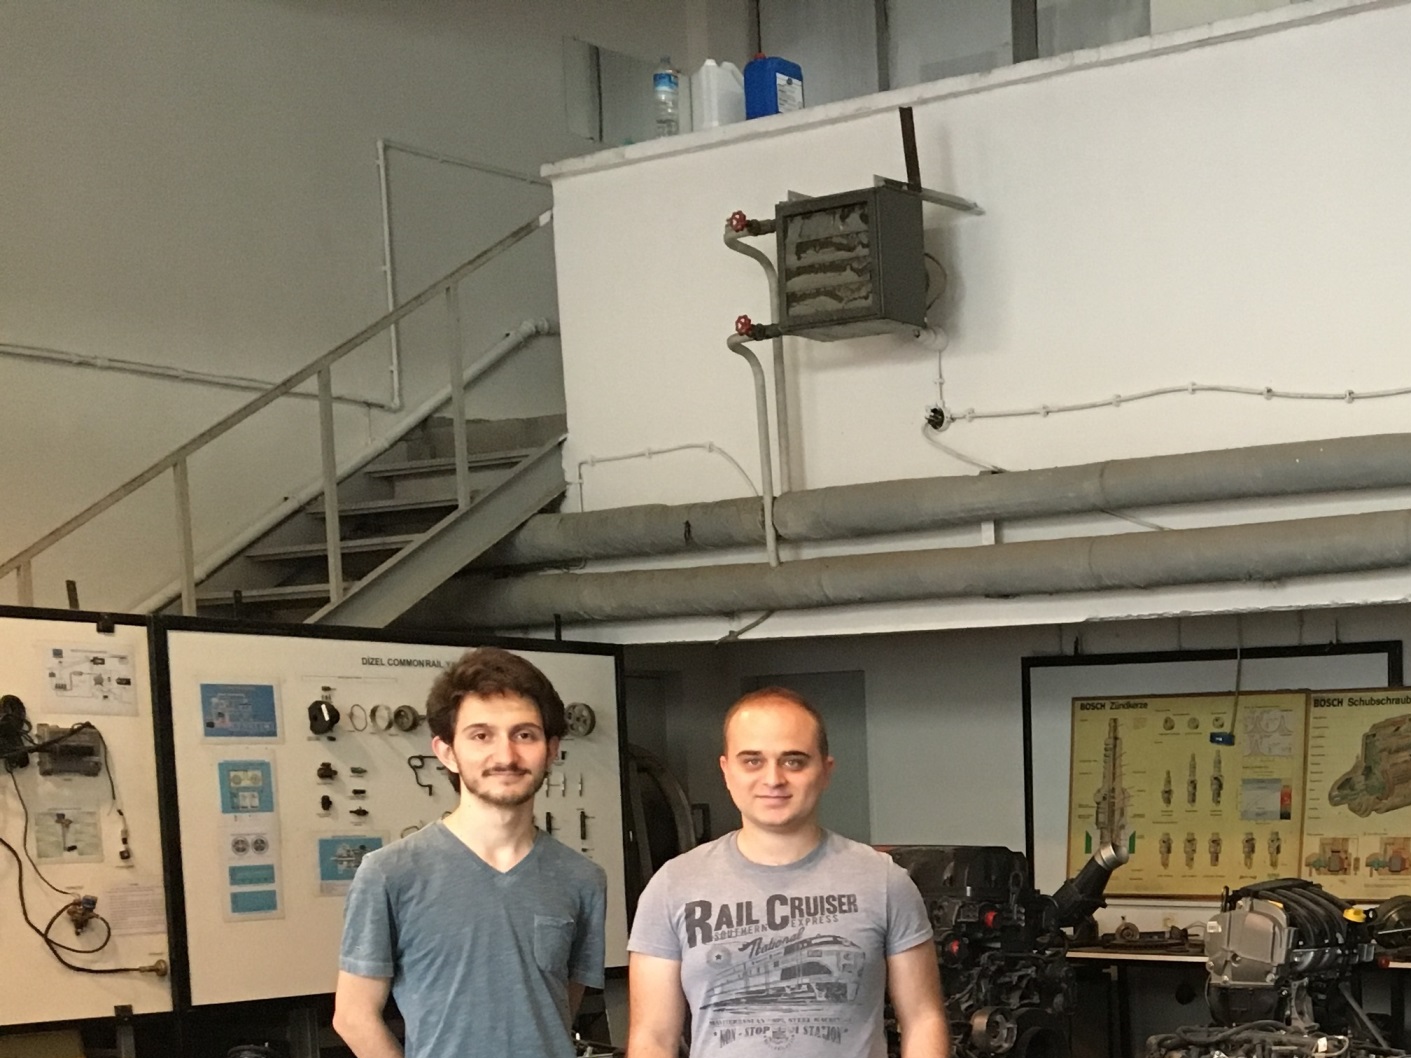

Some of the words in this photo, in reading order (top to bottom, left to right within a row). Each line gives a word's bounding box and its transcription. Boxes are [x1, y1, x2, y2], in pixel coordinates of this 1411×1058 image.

[1080, 702, 1106, 711] BOSCH
[1109, 701, 1148, 710] Zündkerze
[1313, 698, 1344, 708] BOSCH
[685, 900, 760, 949] RAIL
[766, 894, 859, 931] CRUISER
[714, 924, 768, 942] SOUTHERN
[791, 914, 840, 928] EXPRESS
[741, 927, 805, 958] National
[745, 1026, 771, 1037] STOP
